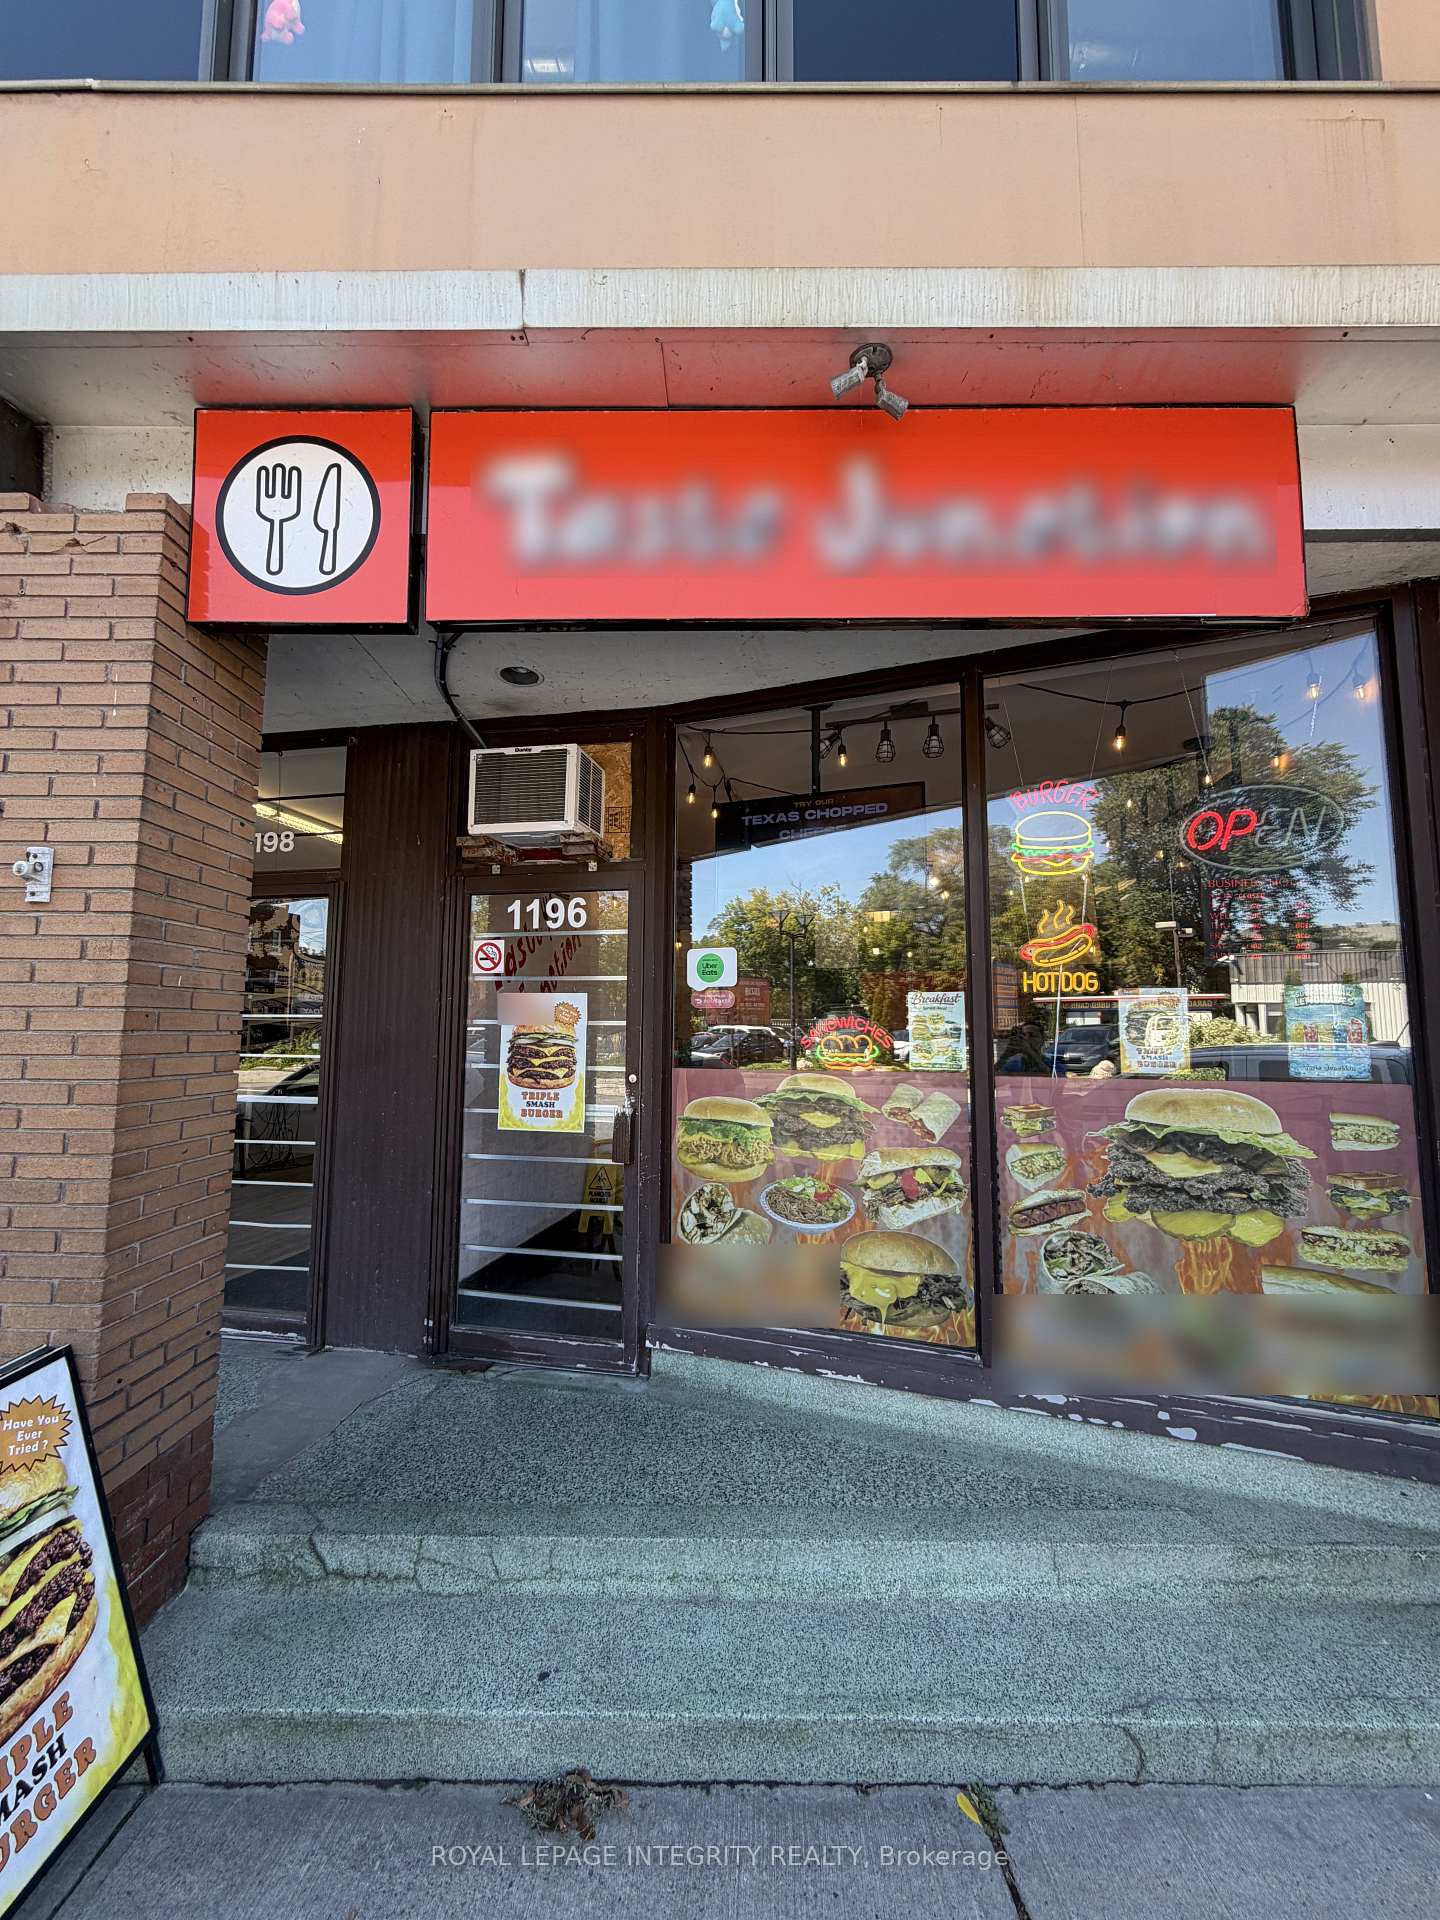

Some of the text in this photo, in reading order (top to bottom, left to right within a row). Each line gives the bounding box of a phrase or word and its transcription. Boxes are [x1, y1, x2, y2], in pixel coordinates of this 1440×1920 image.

[1009, 778, 1100, 812] BURGER
[741, 802, 888, 826] TEXAS CHOPPED
[1186, 806, 1327, 851] OPEN
[507, 896, 587, 930] 1196
[911, 992, 962, 1006] Breakfast
[800, 1015, 894, 1050] SANDWICHES
[521, 1091, 560, 1100] TRIPLE
[520, 1109, 563, 1118] BURGER
[3, 1415, 59, 1431] Have You
[16, 1430, 43, 1442] Ever
[8, 1439, 48, 1456] Tried ?
